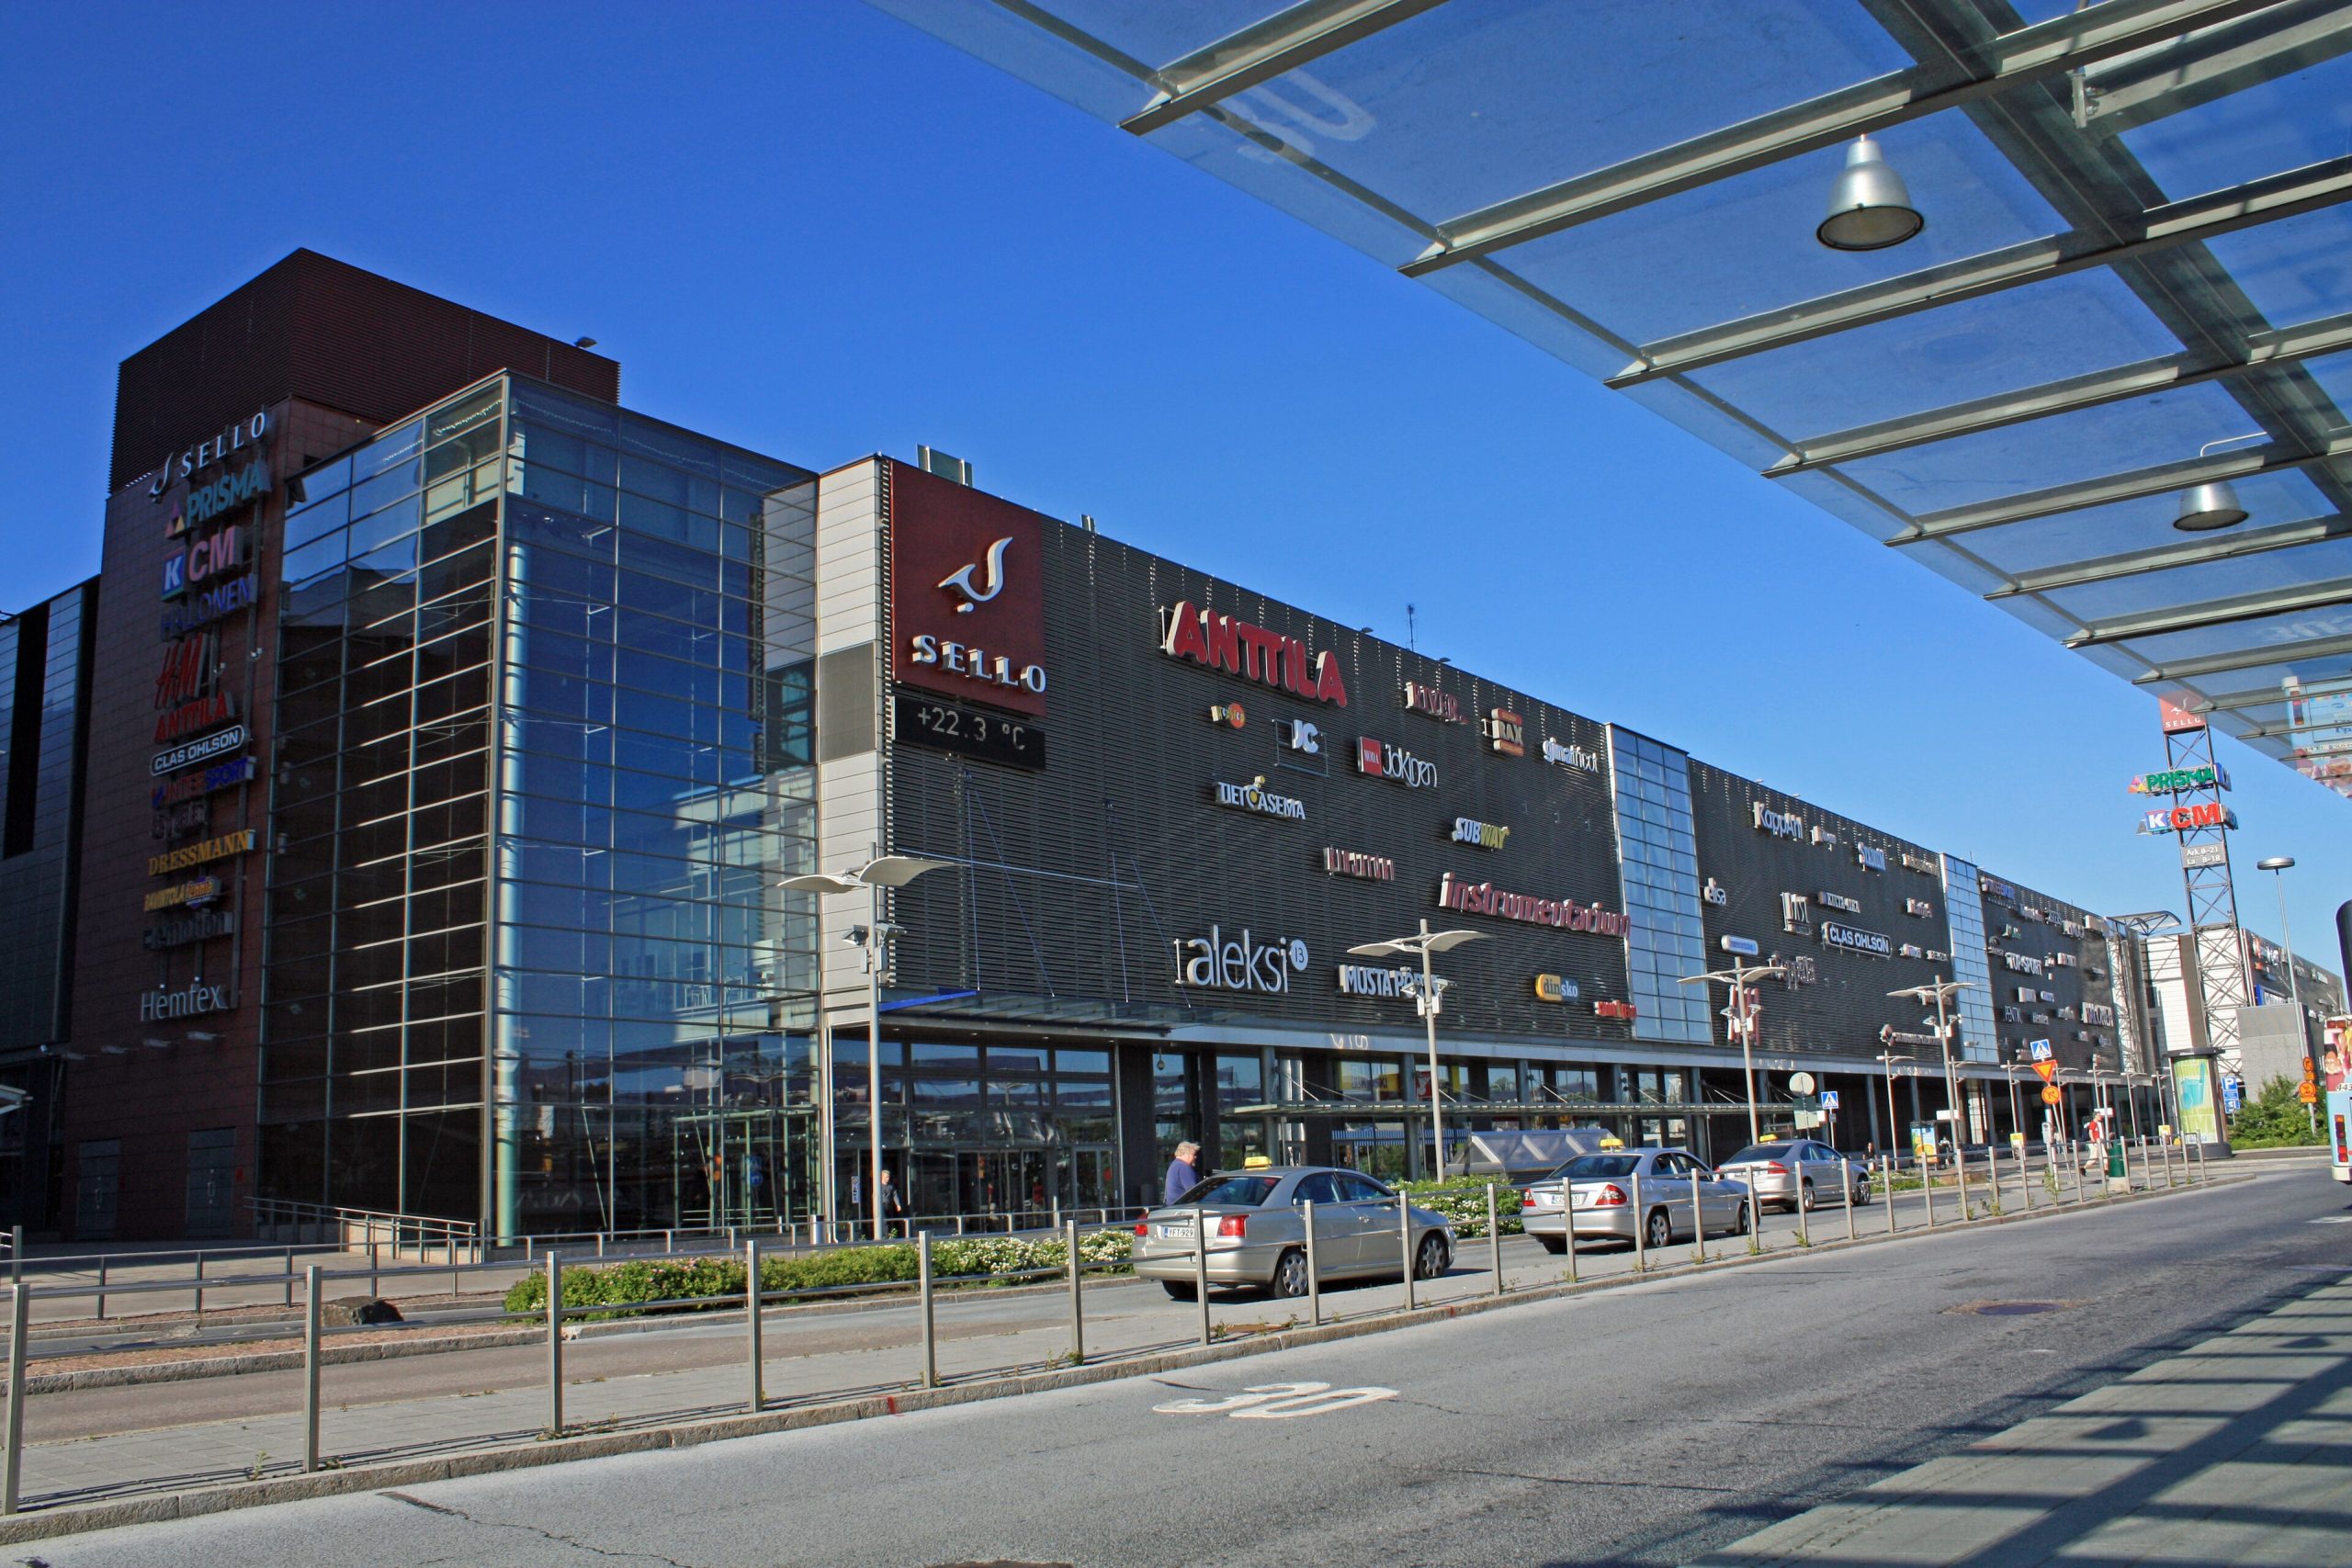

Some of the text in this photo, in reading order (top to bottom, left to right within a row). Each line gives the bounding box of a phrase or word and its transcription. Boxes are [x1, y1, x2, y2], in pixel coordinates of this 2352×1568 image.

[181, 412, 266, 478] SELLO
[187, 463, 268, 525] PRISMA
[189, 525, 236, 582] CM
[912, 635, 1046, 693] SELLO
[1166, 601, 1348, 708] ANTTILA
[154, 692, 231, 744] ANTTILA
[1291, 719, 1318, 754] JC
[1492, 719, 1524, 747] RAX
[154, 730, 239, 772] CLAS OHLSON
[2146, 765, 2216, 791] PRISMA
[1452, 817, 1510, 850] SUBWAY
[2149, 813, 2166, 828] K
[2170, 803, 2222, 829] CM
[149, 829, 251, 875] DRESSMANN
[1186, 924, 1288, 993] aleksi
[1829, 925, 1854, 946] CLAS
[1854, 932, 1890, 953] OHLSON
[1339, 964, 1393, 998] MUSTA
[141, 984, 221, 1021] Hemtex
[2224, 1078, 2234, 1090] P
